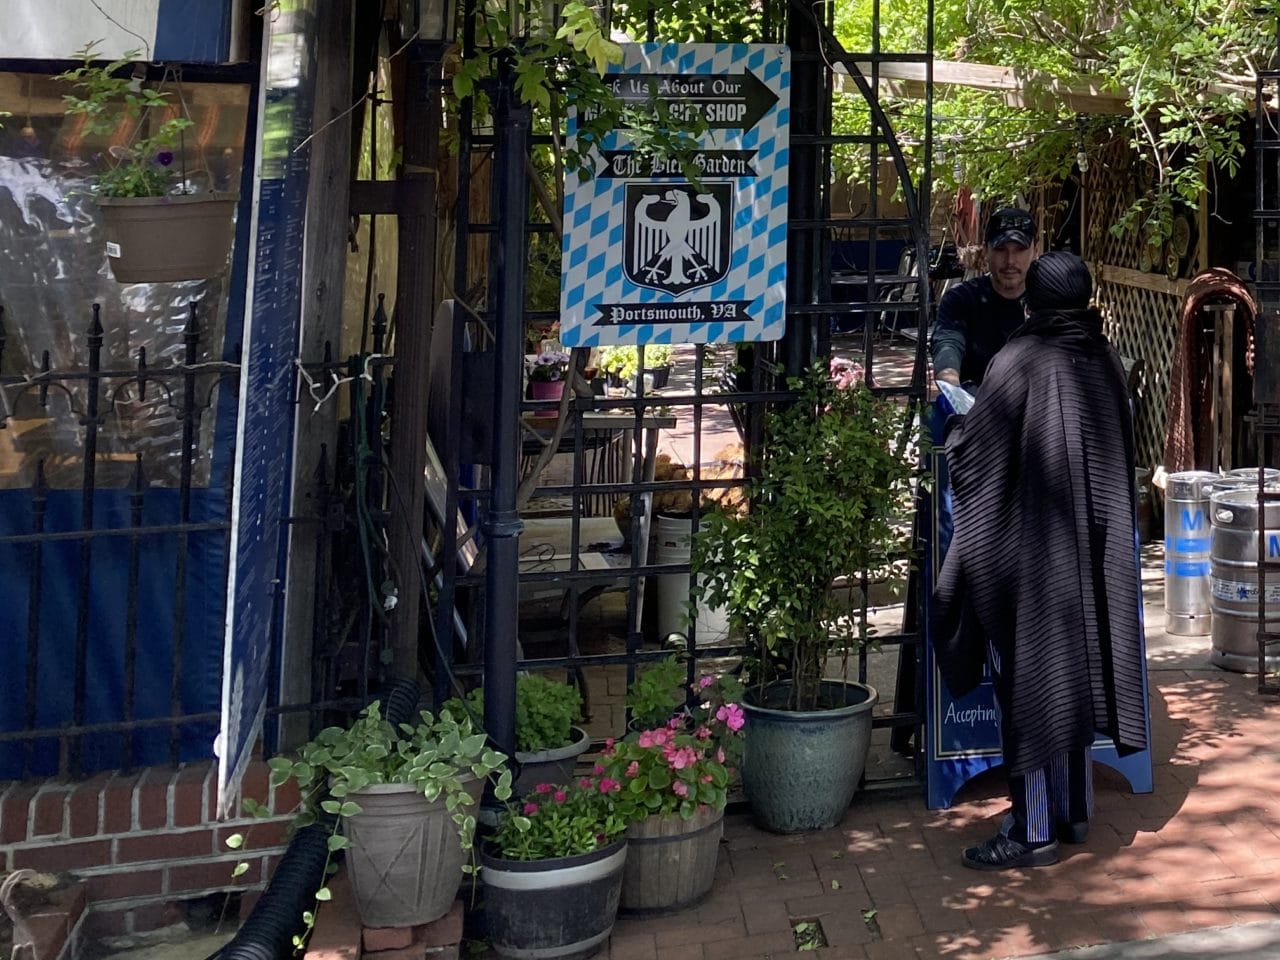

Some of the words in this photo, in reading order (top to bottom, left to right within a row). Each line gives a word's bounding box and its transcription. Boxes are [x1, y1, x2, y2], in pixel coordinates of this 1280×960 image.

[630, 79, 649, 91] Us
[657, 79, 705, 94] About
[712, 79, 742, 94] Our
[706, 103, 747, 122] SHOP
[612, 154, 642, 177] The
[610, 304, 705, 324] Portsmouth,
[710, 303, 737, 318] VA
